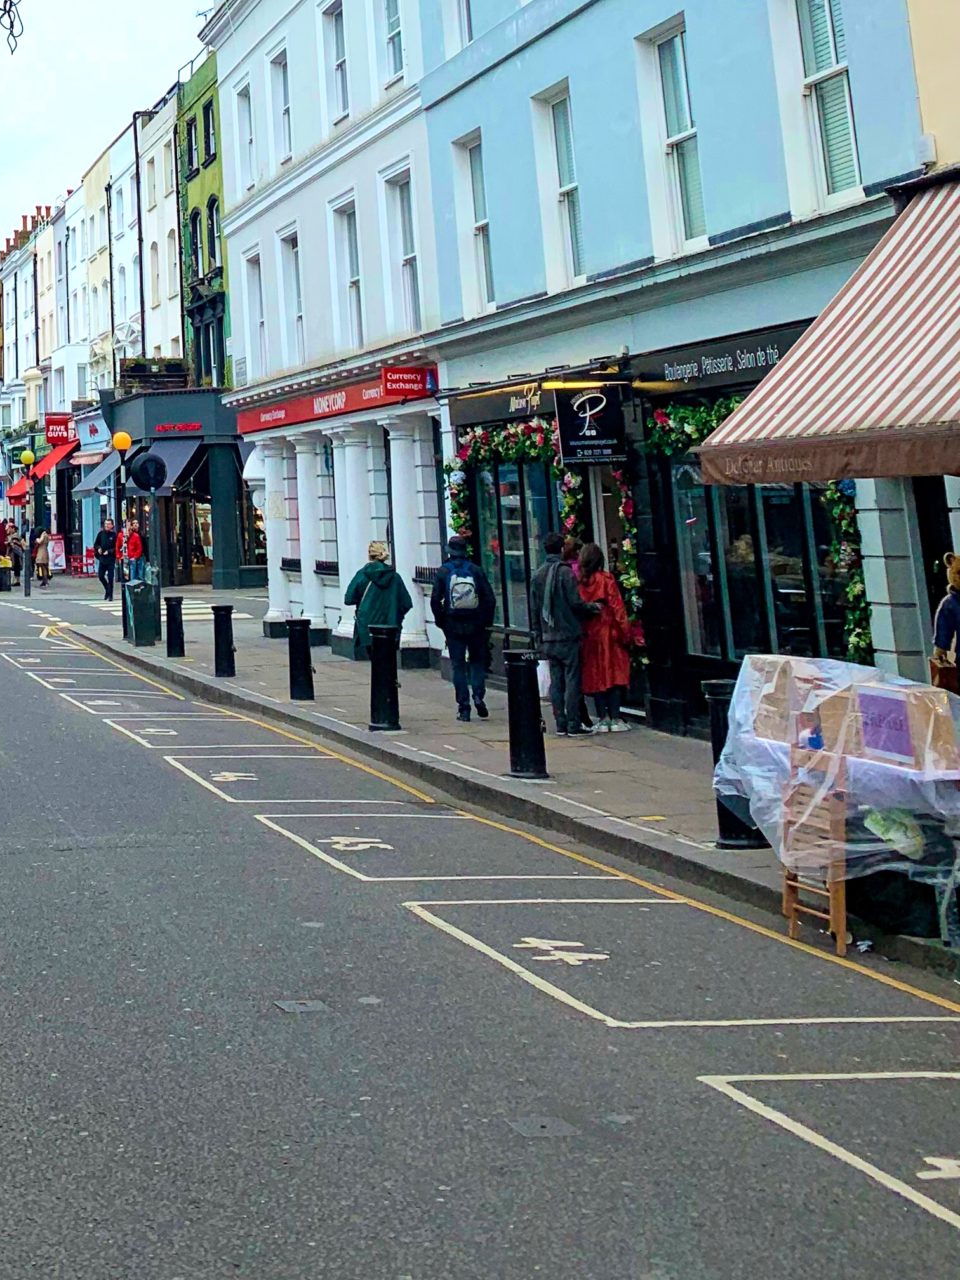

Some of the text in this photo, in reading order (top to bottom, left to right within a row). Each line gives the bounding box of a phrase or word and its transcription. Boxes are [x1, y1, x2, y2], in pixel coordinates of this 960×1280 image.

[736, 348, 755, 369] Salon
[756, 346, 765, 366] de
[766, 344, 779, 364] thé
[387, 372, 421, 381] Currency
[387, 382, 423, 390] Exchange
[313, 391, 347, 415] MONEYCORP
